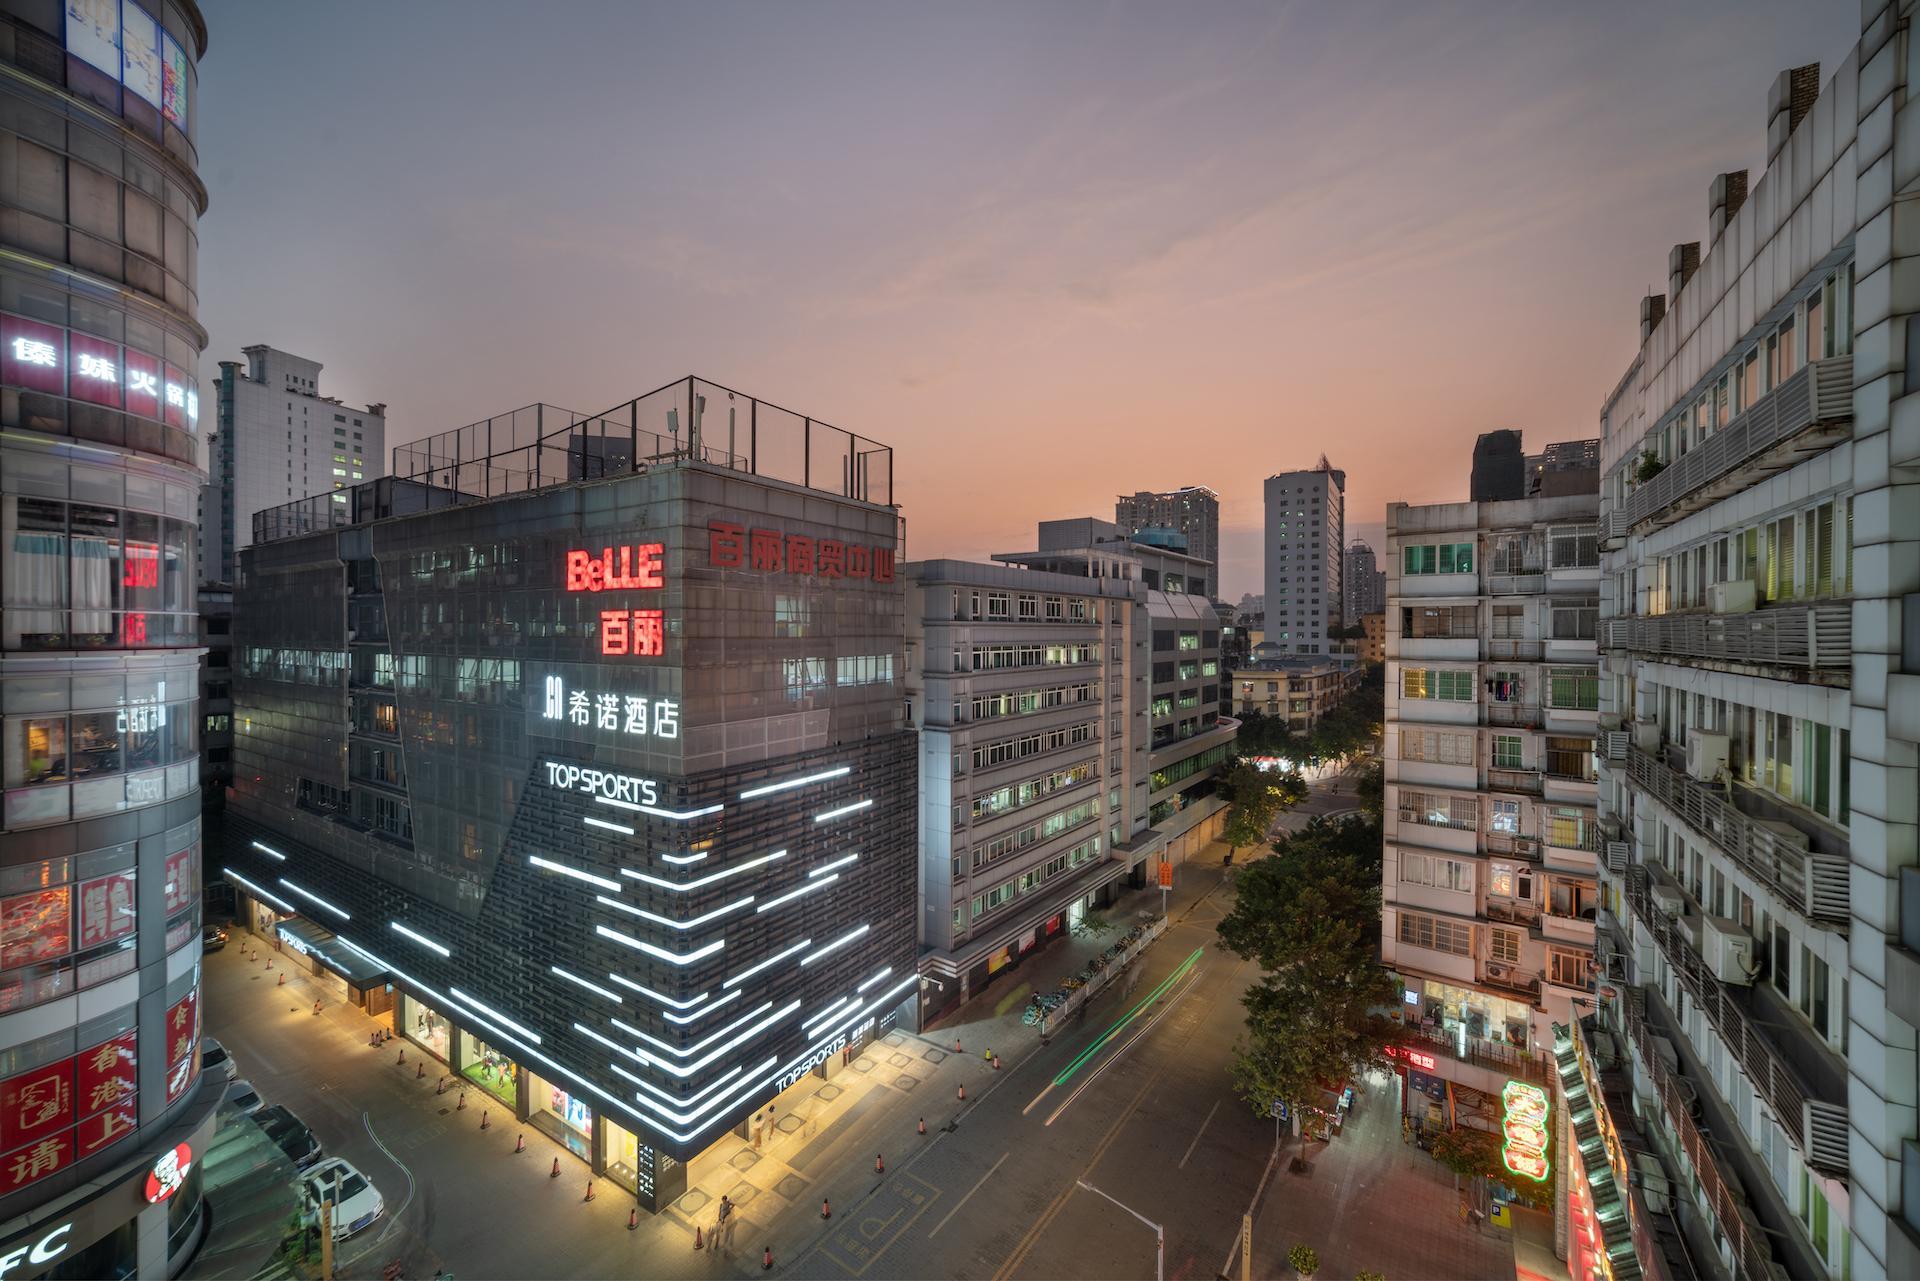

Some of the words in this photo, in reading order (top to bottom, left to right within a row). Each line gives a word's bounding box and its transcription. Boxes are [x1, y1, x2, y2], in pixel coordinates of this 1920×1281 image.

[708, 519, 895, 584] 百丽商贸中心
[601, 610, 663, 655] 百丽
[569, 691, 678, 738] 希诺酒店
[545, 762, 657, 806] TOPSPORTS
[88, 1043, 125, 1111] 香港
[775, 1033, 846, 1094] TOPSPORTS
